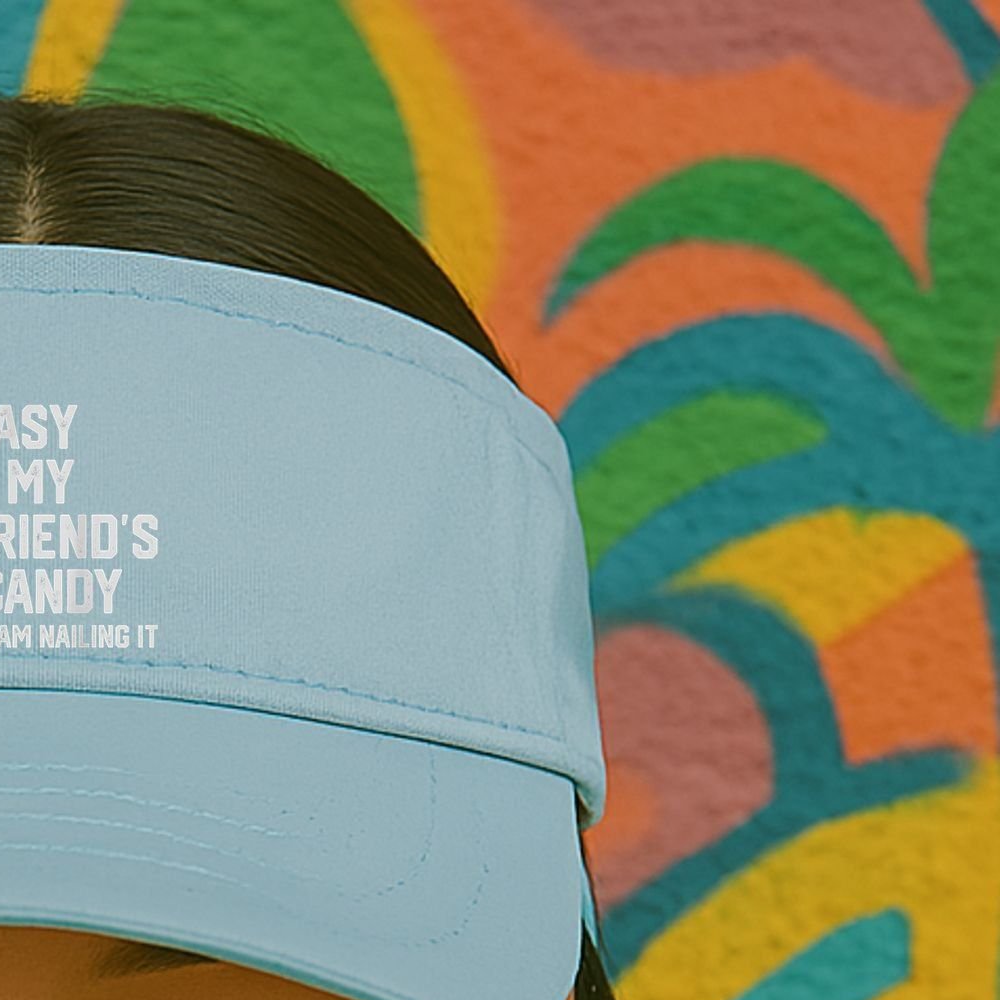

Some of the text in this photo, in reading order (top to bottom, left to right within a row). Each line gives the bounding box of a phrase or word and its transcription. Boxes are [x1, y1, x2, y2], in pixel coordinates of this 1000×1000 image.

[7, 459, 74, 504] MY
[39, 624, 130, 648] NAILING
[137, 624, 159, 648] IT
